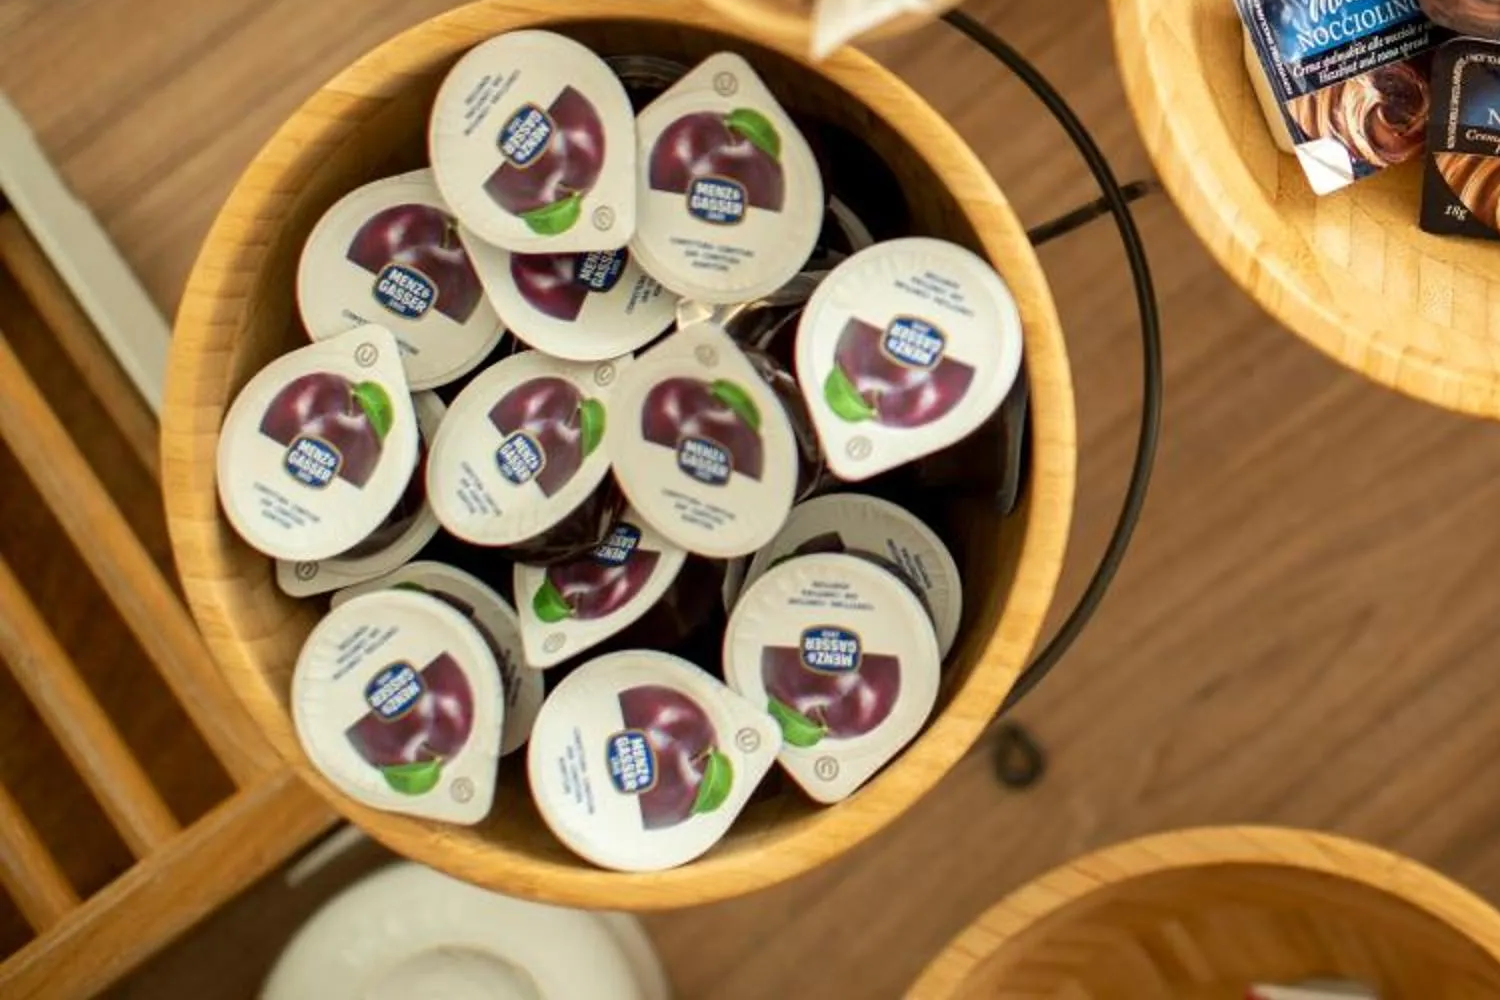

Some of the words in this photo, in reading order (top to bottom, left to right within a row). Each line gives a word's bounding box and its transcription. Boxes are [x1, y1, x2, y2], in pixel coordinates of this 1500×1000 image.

[502, 110, 544, 154] GASSER
[691, 195, 742, 214] GASSER
[378, 279, 426, 312] GASSER
[890, 324, 941, 352] GASSER
[288, 450, 331, 481] GASSER
[499, 443, 530, 480] GASSER
[680, 451, 727, 476] GASSER
[804, 637, 856, 654] GASSER
[370, 668, 413, 706] GASSER
[615, 736, 637, 790] GASSER
